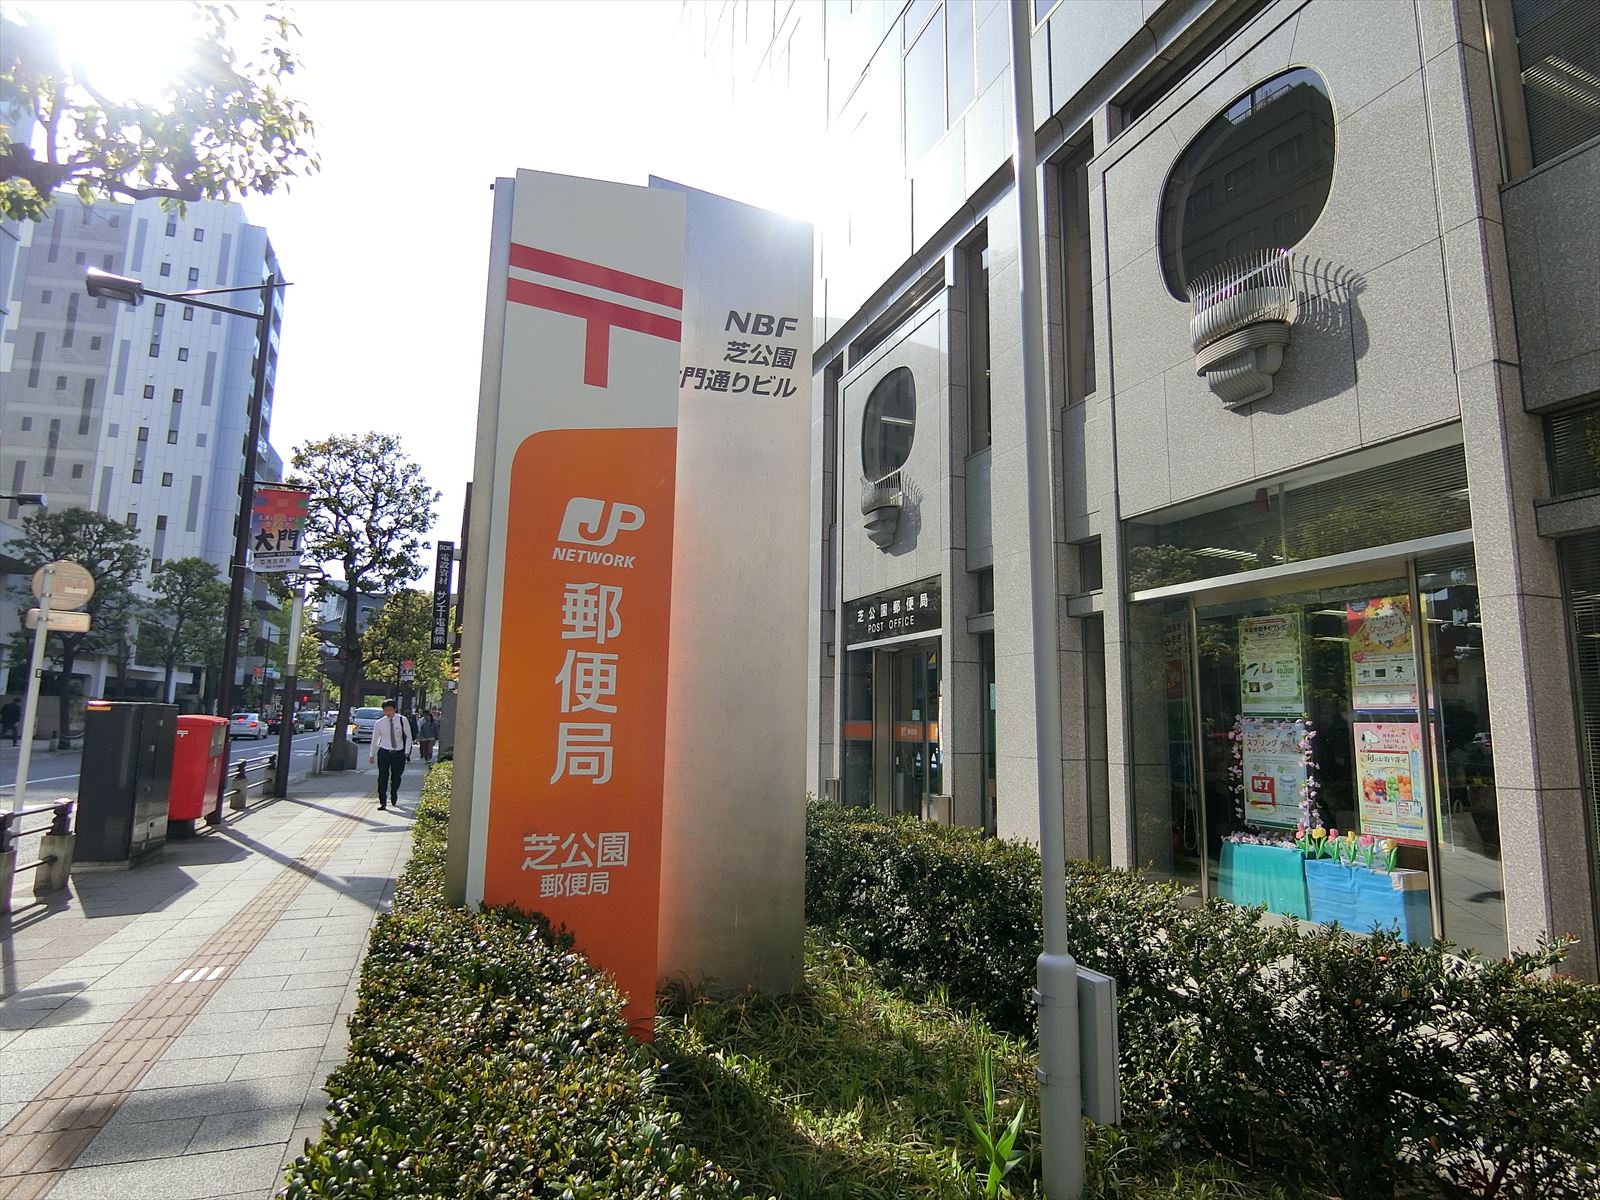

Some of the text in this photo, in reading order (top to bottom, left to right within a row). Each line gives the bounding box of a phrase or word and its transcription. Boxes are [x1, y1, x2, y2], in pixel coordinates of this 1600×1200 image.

[724, 310, 799, 338] NBF
[723, 341, 798, 370] 芝公園
[680, 366, 798, 398] 門通りビル
[255, 528, 300, 551] 大門
[552, 547, 636, 569] NETWORK
[857, 592, 929, 623] 芝公園郵便局
[867, 614, 915, 634] POST OFFICE
[550, 582, 623, 786] 郵便局
[1247, 739, 1279, 747] スプリング
[521, 831, 630, 871] 芝公園
[539, 871, 610, 898] 郵便局
